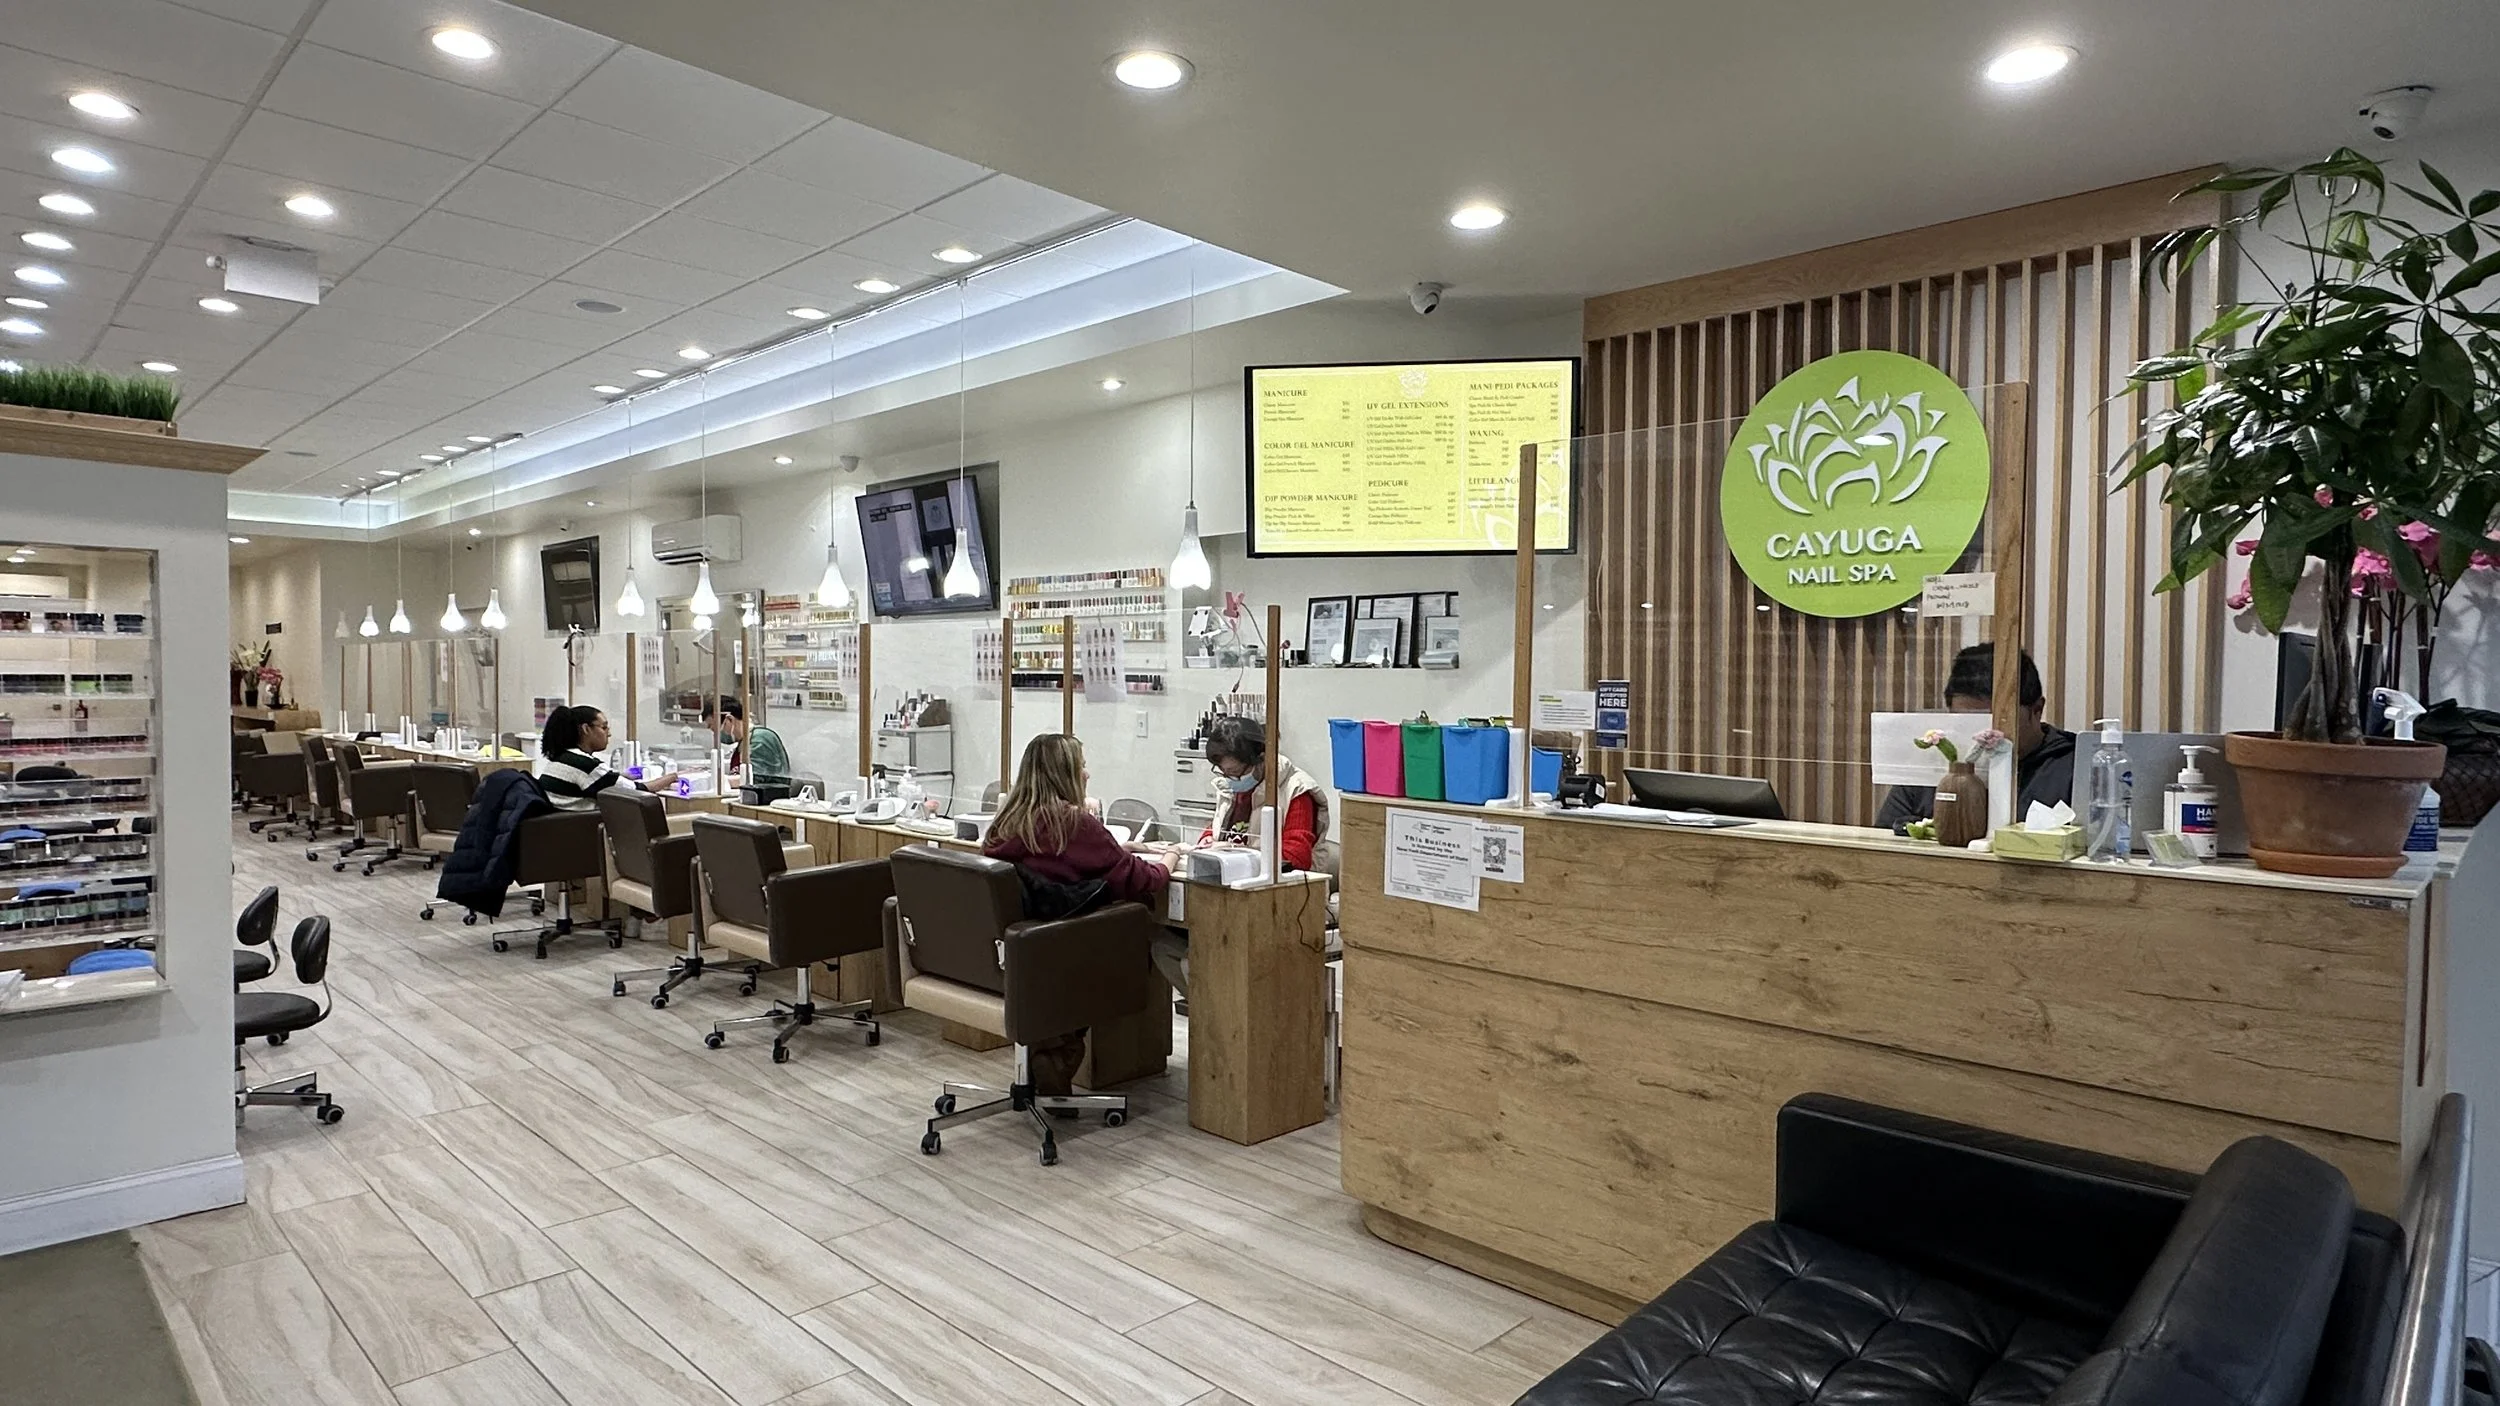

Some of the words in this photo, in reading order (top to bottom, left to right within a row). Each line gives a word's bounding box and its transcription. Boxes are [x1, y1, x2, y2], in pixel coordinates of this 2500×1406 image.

[1469, 382, 1492, 390] MANI
[1494, 382, 1514, 390] PEDI
[1516, 381, 1558, 389] PACKAGES
[1263, 389, 1308, 398] MANICURE
[1366, 402, 1379, 410] UV
[1380, 402, 1396, 410] GEL
[1398, 400, 1449, 409] EXTENSIONS
[1263, 441, 1292, 450] COLOR
[1310, 440, 1355, 449] MANICURE
[1368, 479, 1409, 487] PEDICURE
[1468, 477, 1497, 485] LITTLE
[1264, 494, 1279, 502] DIP
[1280, 494, 1314, 502] POWDER
[1316, 493, 1358, 501] MANICURE
[1766, 524, 1923, 560] CAYUGA
[1788, 565, 1843, 585] NAIL
[1848, 562, 1897, 583] SPA
[1599, 698, 1628, 707] HERE
[1405, 834, 1422, 843] This
[1424, 838, 1460, 849] Business
